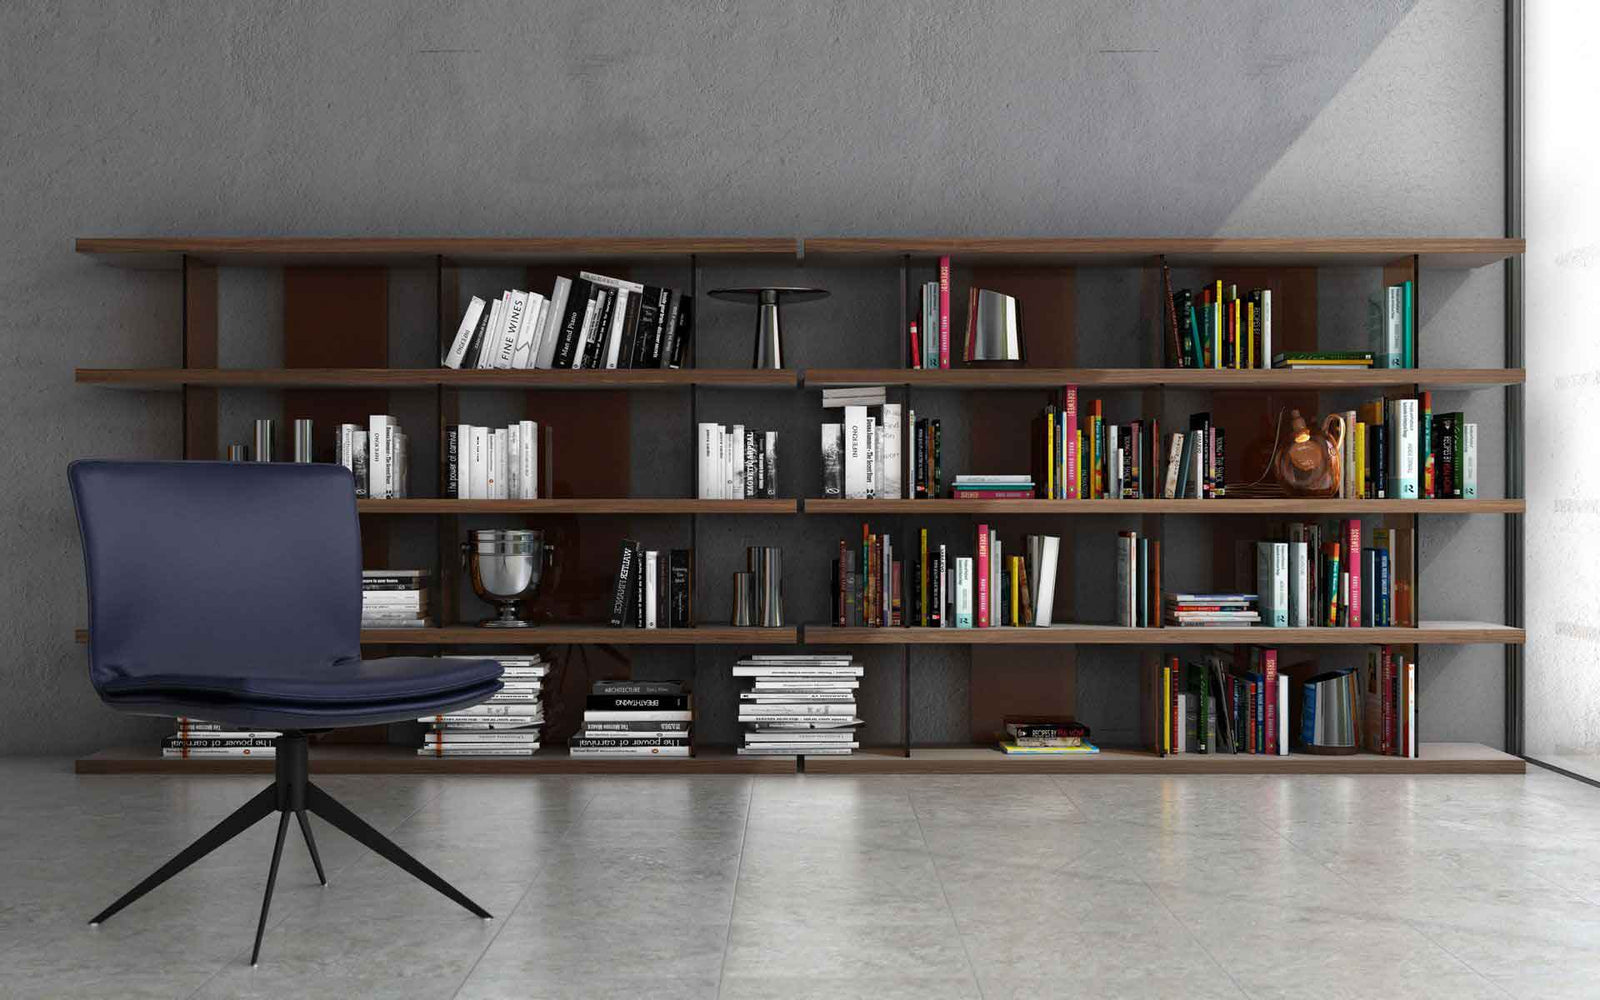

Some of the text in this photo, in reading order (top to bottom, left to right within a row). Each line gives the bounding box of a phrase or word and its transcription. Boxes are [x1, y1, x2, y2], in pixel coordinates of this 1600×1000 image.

[502, 300, 524, 361] FINE WINES
[561, 312, 577, 358] Man and Piano
[448, 463, 458, 481] power
[1215, 466, 1224, 482] SHACK
[171, 738, 272, 748] The power of carnval
[579, 737, 680, 747] The power of carnival
